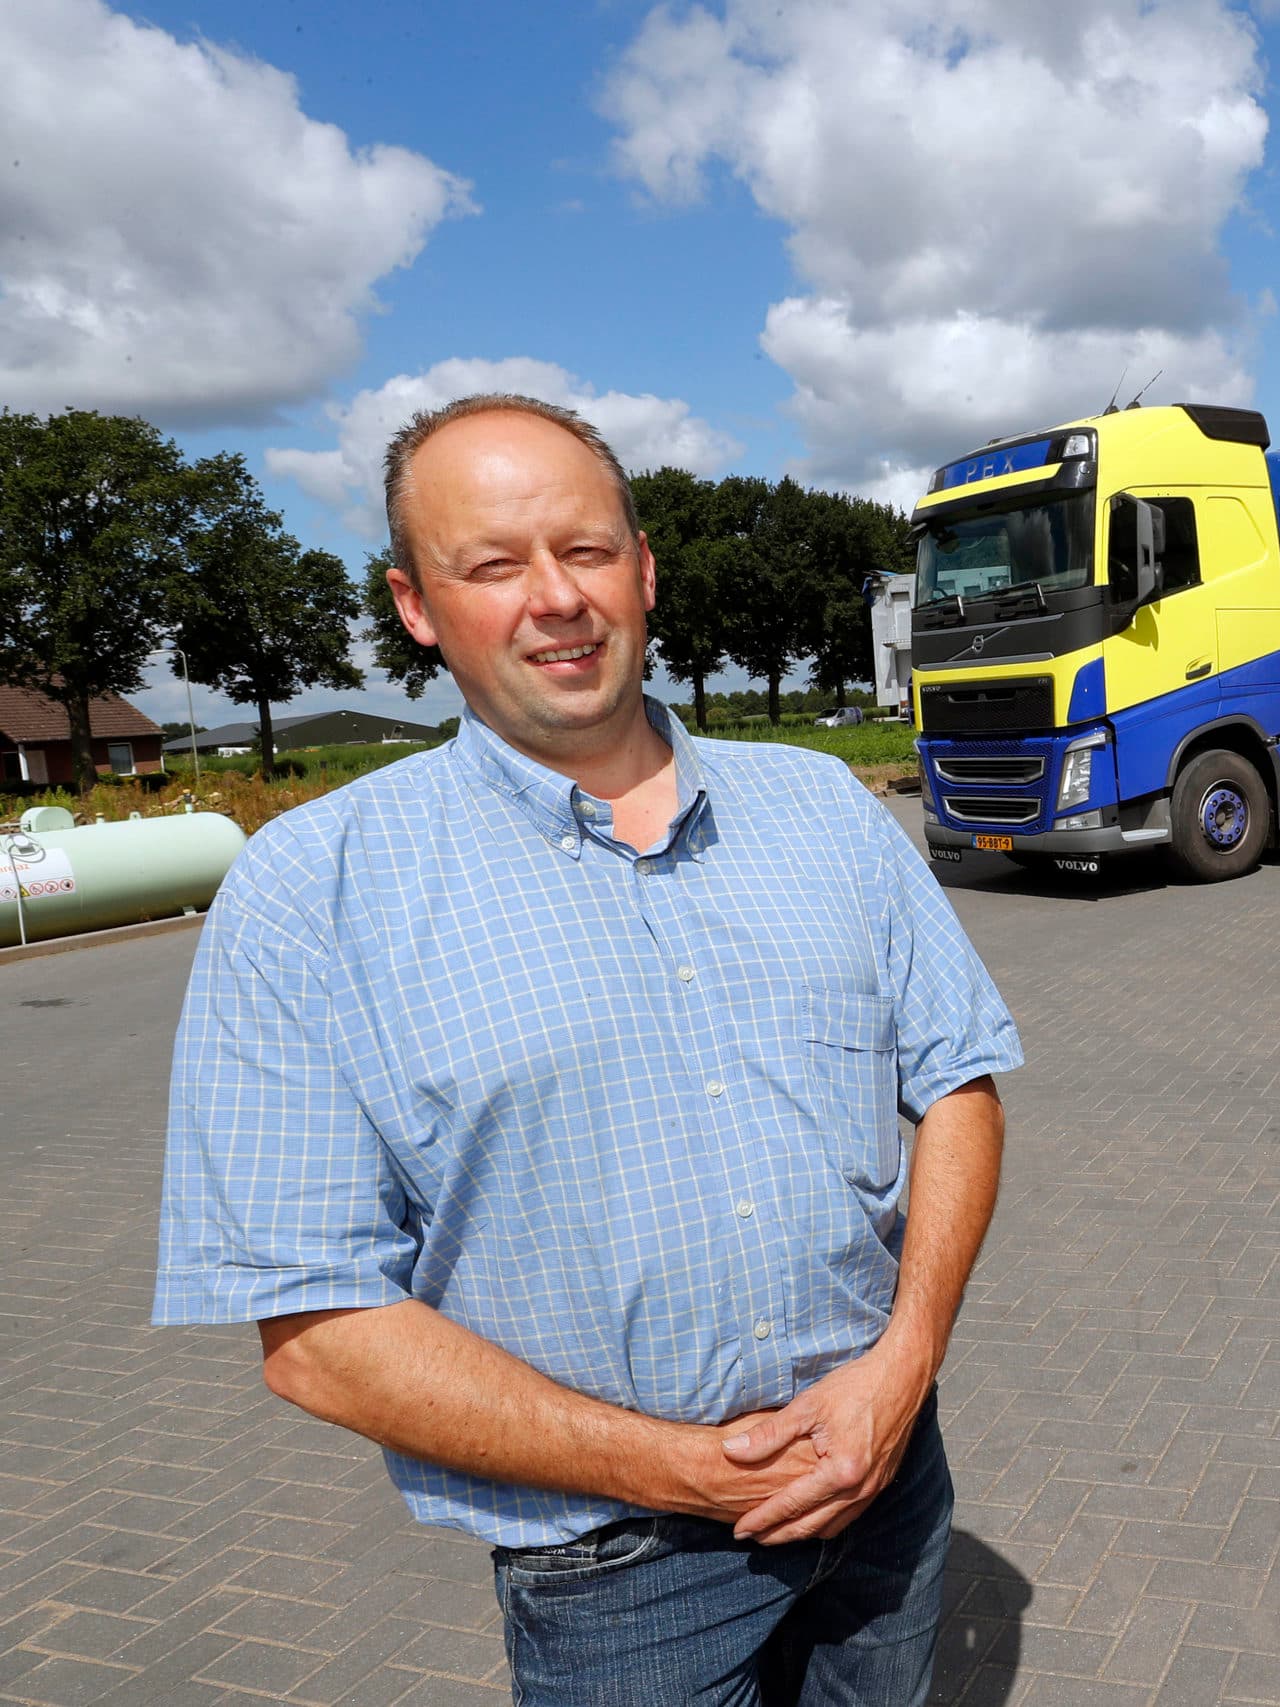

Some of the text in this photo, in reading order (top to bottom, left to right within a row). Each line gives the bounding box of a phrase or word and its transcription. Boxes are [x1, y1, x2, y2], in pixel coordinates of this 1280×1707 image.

[965, 451, 1018, 484] PEX
[931, 849, 961, 861] VOLVO
[1054, 859, 1098, 872] VOLVO
